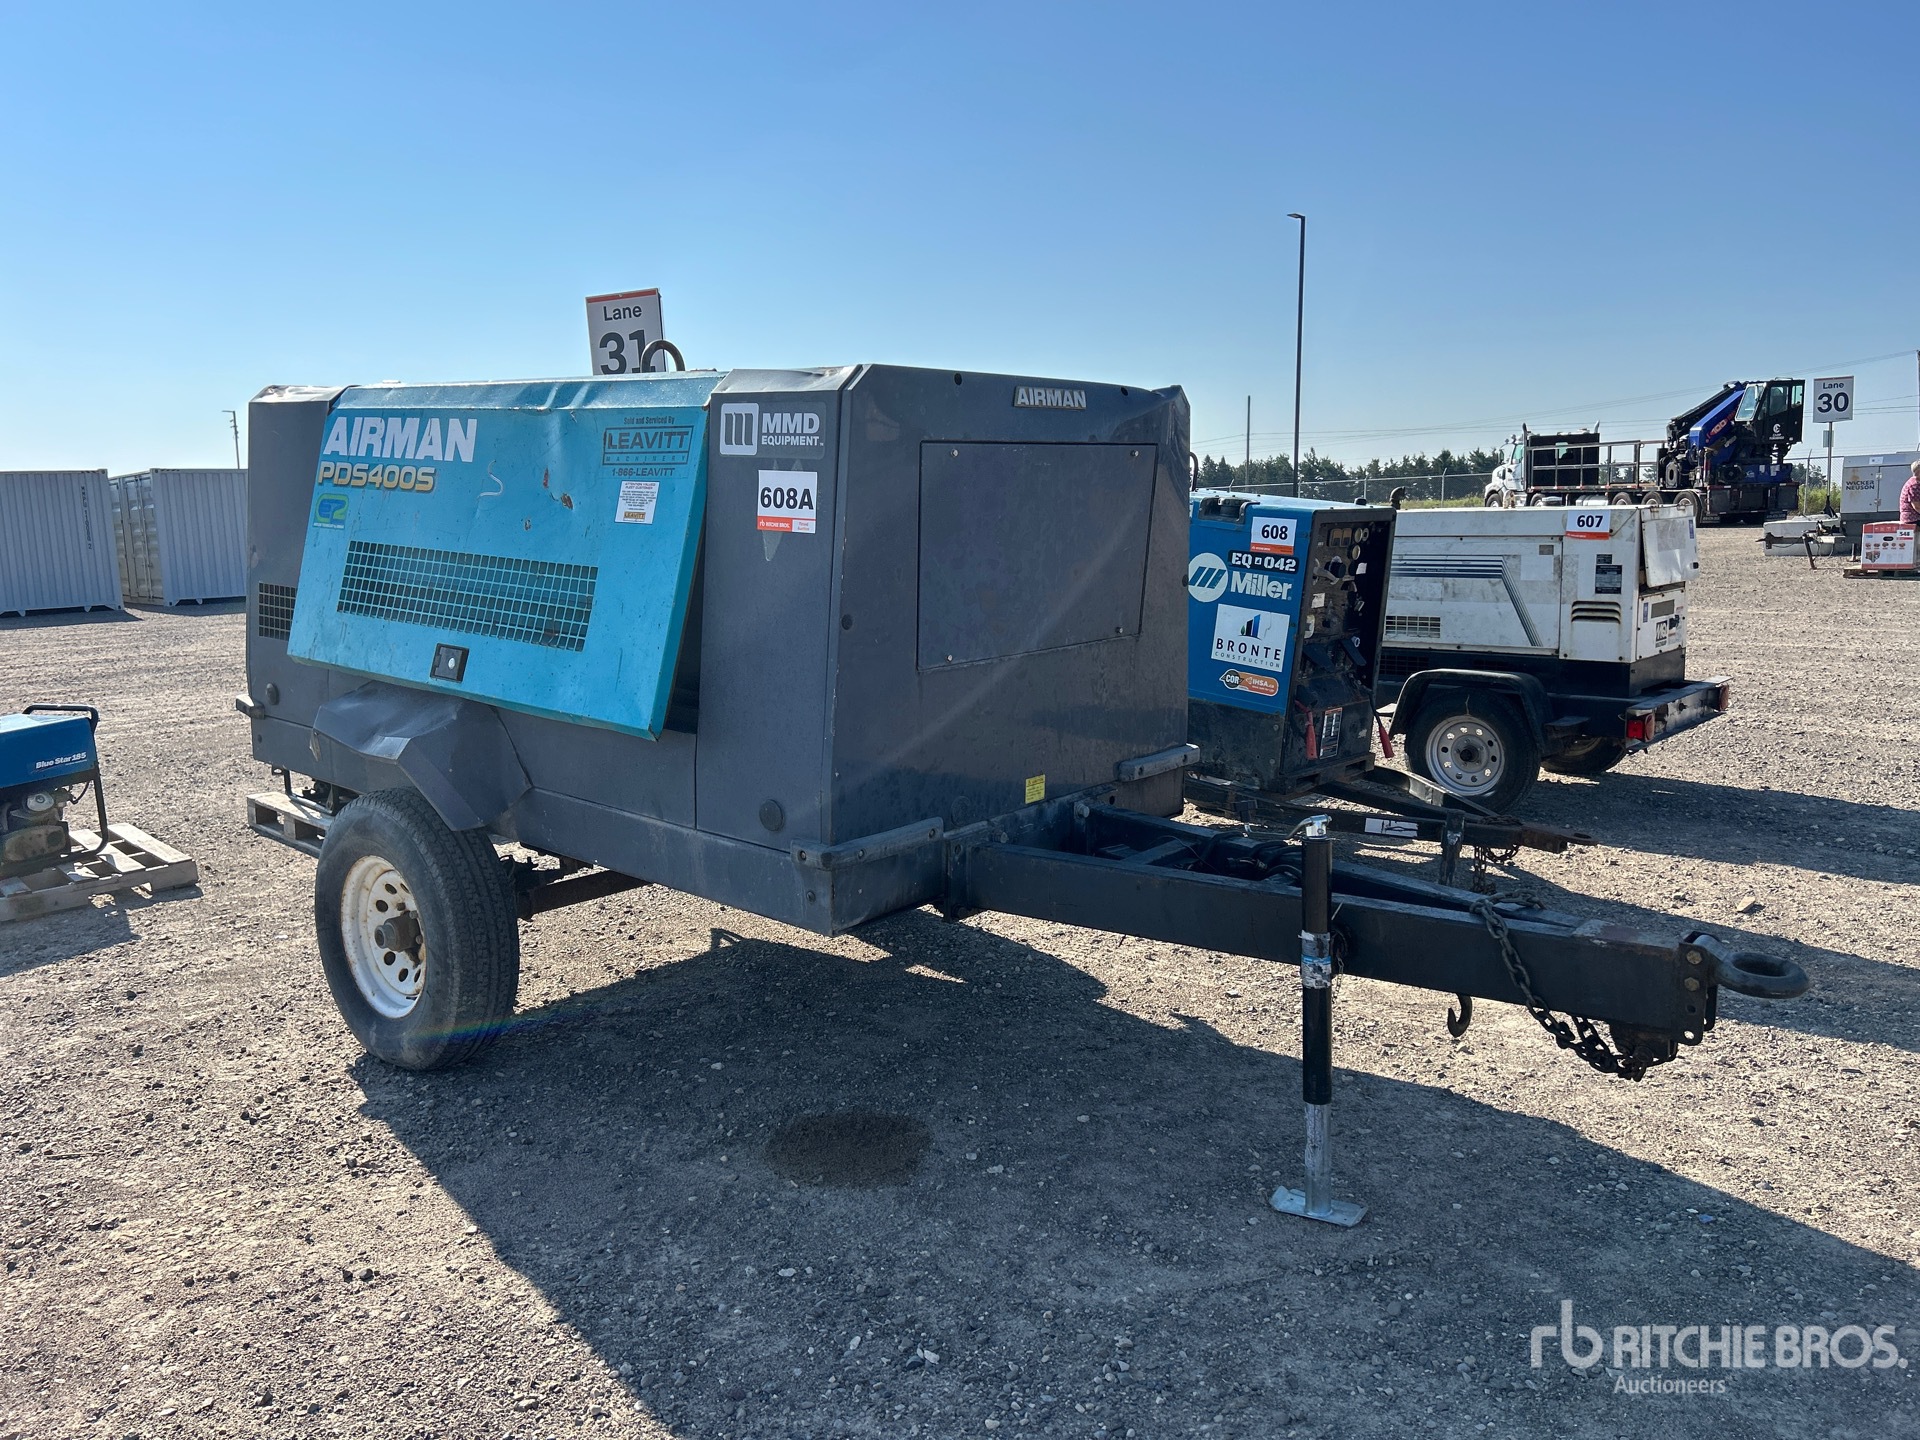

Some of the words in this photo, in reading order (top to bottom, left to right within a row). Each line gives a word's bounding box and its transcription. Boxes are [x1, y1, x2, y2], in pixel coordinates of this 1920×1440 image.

[603, 305, 642, 321] Lane
[599, 329, 656, 375] 31
[1822, 382, 1845, 390] Lane
[1017, 386, 1087, 408] AIRMAN
[1817, 392, 1849, 413] 30
[624, 416, 634, 424] Sold
[762, 412, 820, 434] MMD
[323, 416, 478, 463] AIRMAN
[607, 431, 689, 449] LEAVITT
[761, 435, 819, 446] EQUIPMENT
[606, 455, 685, 463] MACHINERY
[317, 461, 436, 492] PDS400S
[612, 467, 675, 477] 1-866-LEAVITT
[761, 487, 814, 509] 608A
[1577, 515, 1604, 528] 607
[1261, 524, 1288, 540] 608
[1230, 570, 1293, 600] Miller
[1216, 638, 1282, 661] BRONTE
[1215, 651, 1280, 668] CONSTRUCTION
[1225, 674, 1240, 685] COR
[35, 760, 55, 769] Blue
[54, 756, 71, 765] Star
